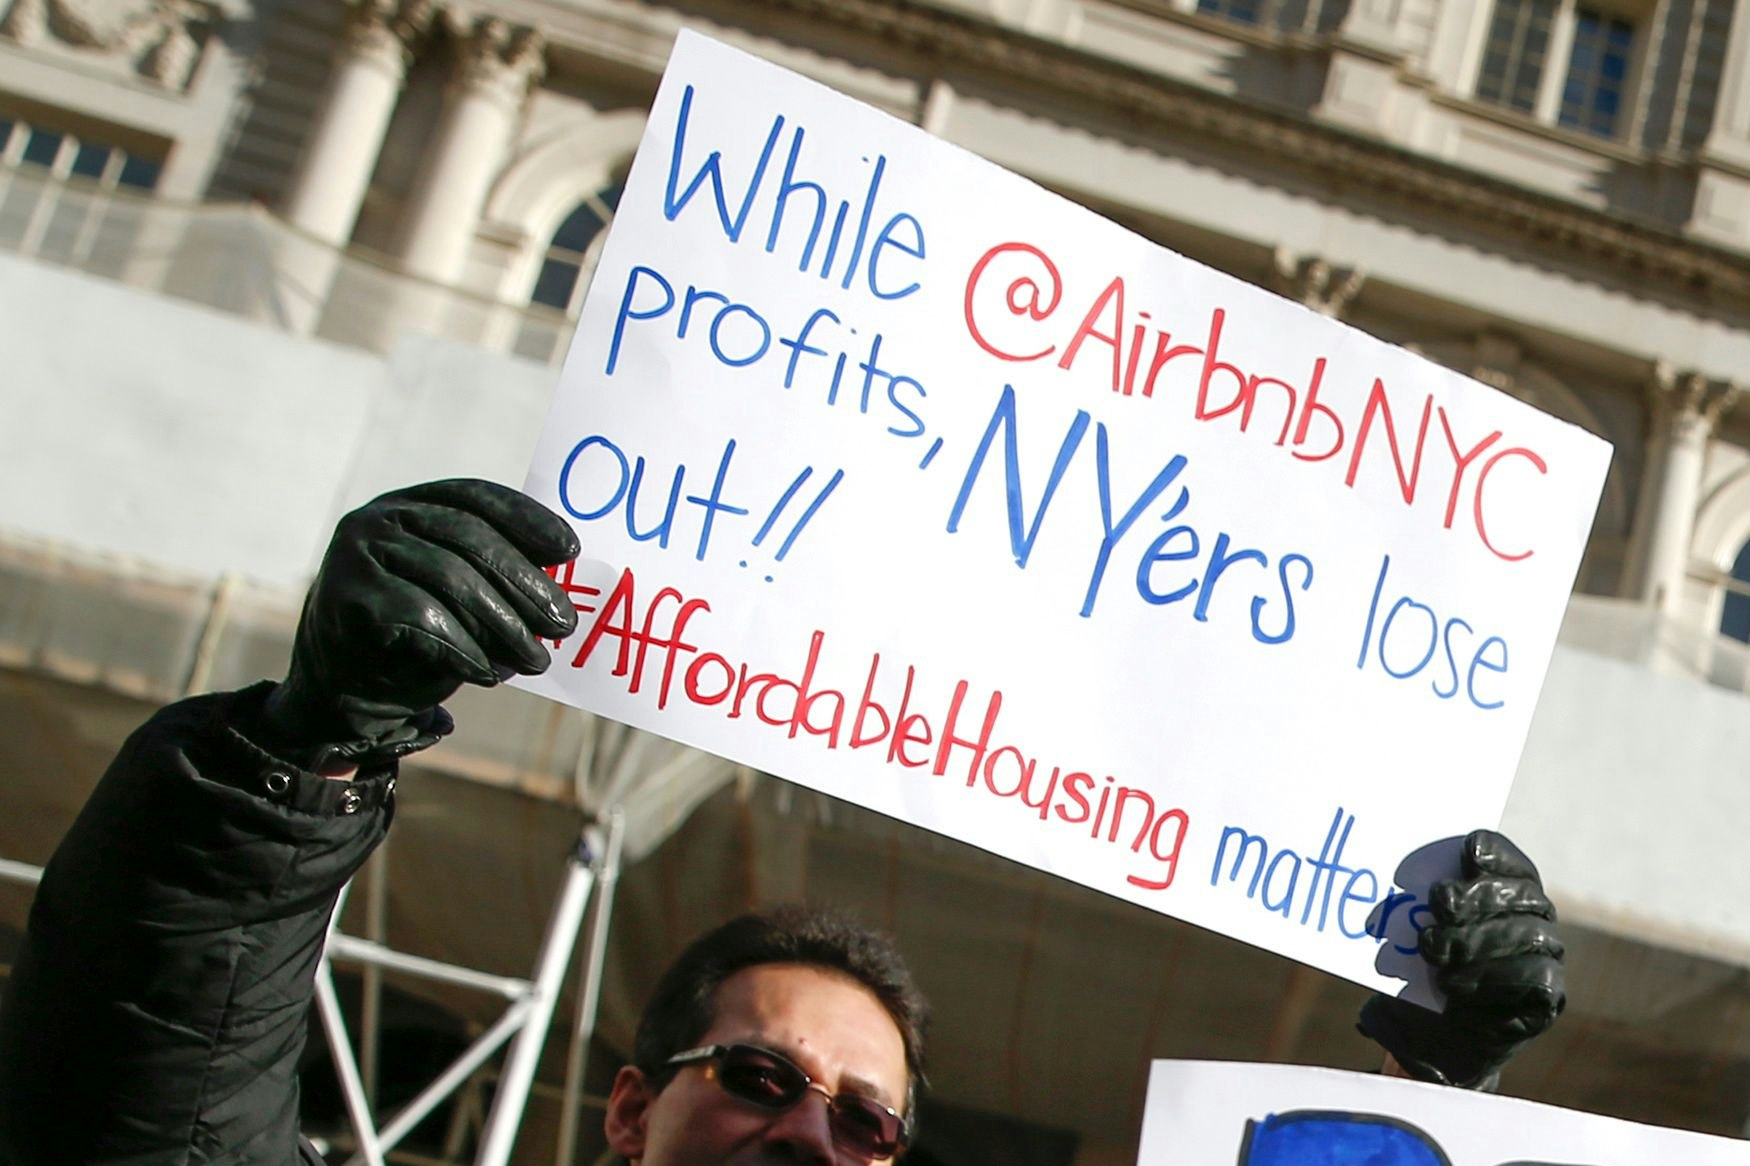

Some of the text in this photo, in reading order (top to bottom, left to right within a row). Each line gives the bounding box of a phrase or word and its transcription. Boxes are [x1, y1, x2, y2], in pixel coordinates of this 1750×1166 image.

[558, 435, 845, 583] out!!
[604, 265, 1508, 710] profits, NY'ers lose
[663, 84, 1547, 561] While @AirbnbNYC
